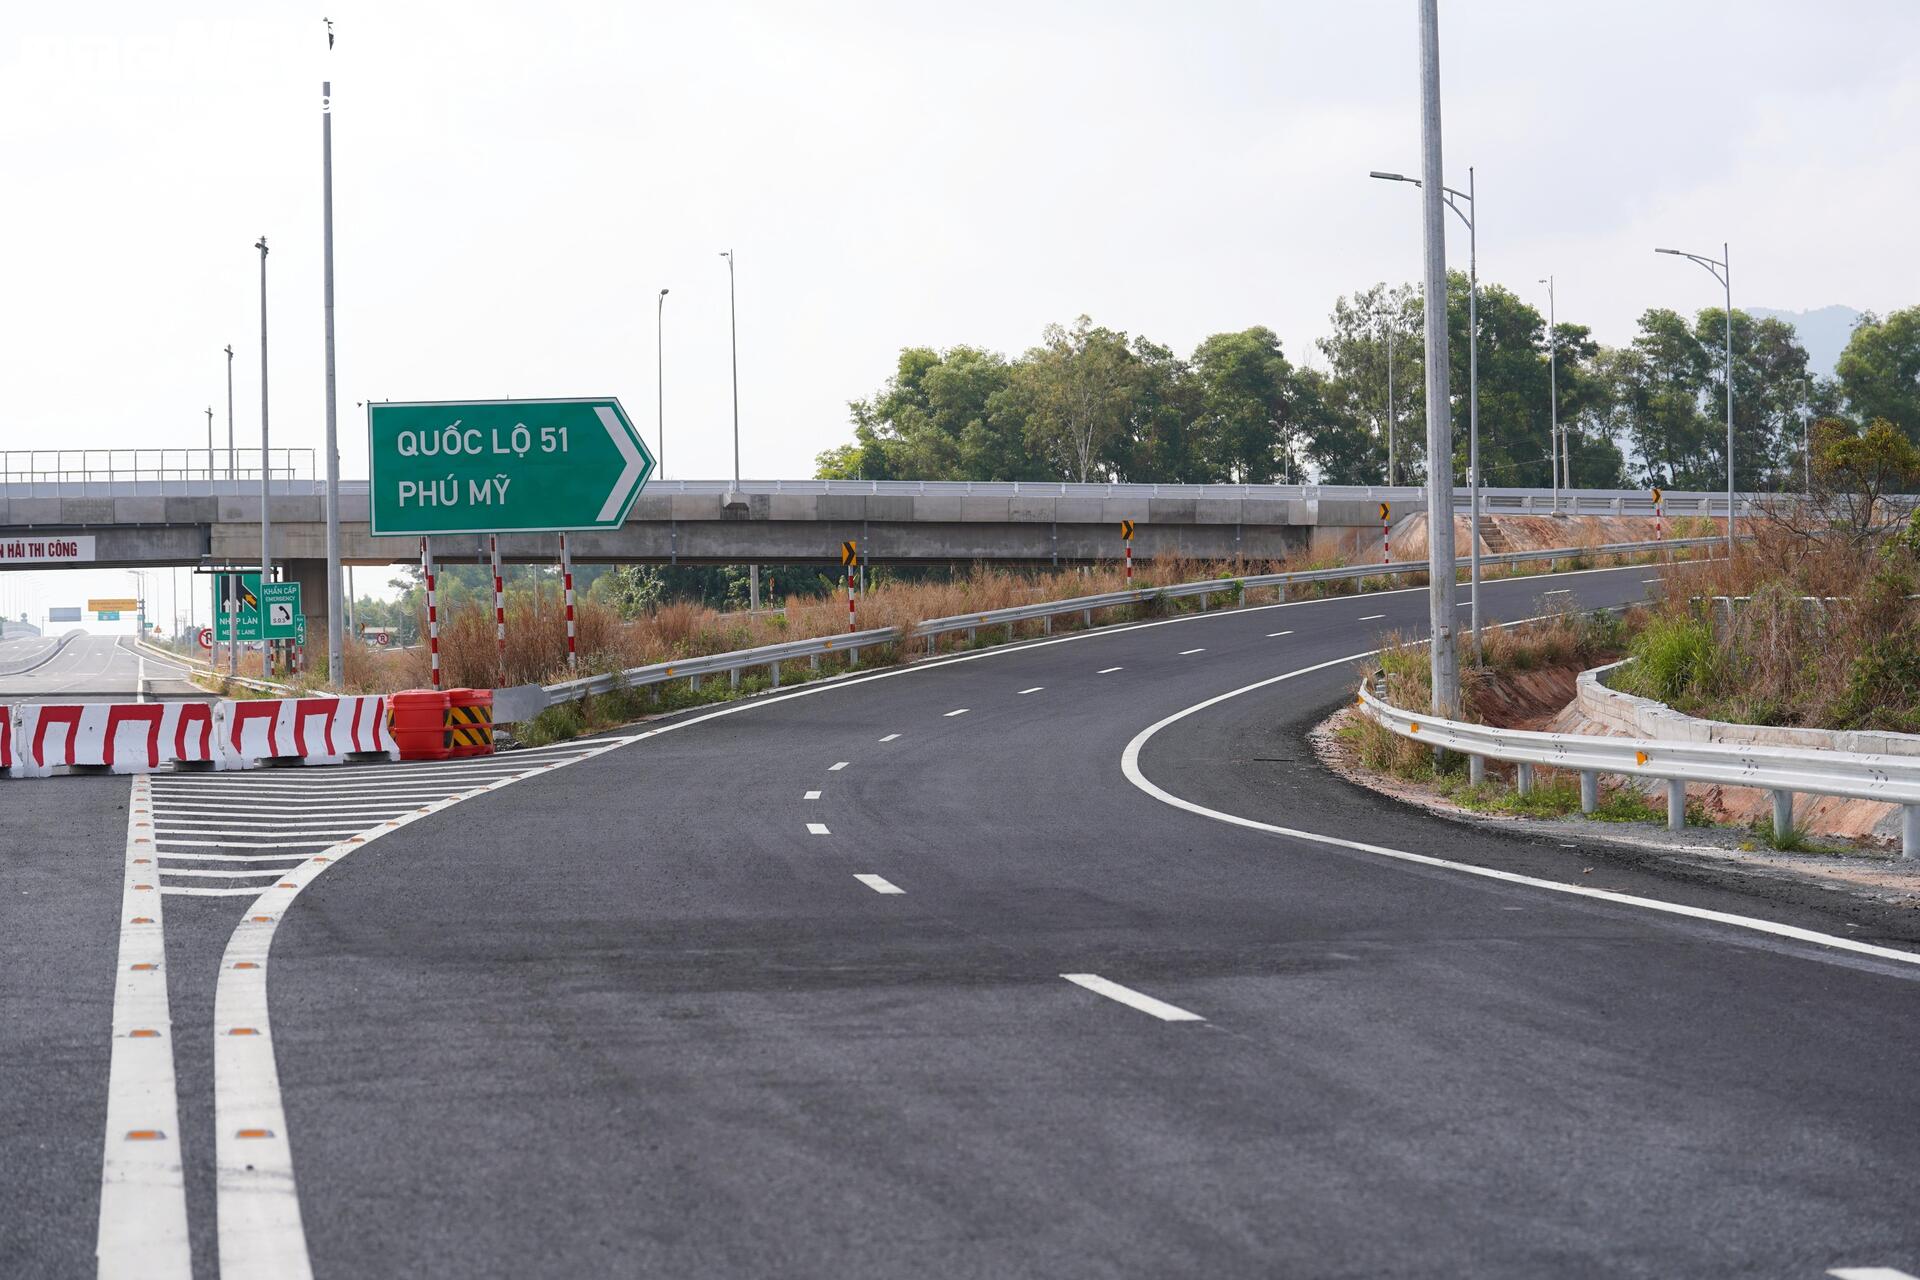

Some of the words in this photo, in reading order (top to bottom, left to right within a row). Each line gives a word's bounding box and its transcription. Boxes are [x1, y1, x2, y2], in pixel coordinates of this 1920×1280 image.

[397, 419, 483, 457] QUỐC
[491, 422, 531, 458] LỘ
[540, 426, 569, 453] 51
[398, 473, 459, 507] PHÚ
[469, 473, 511, 506] MỸ
[7, 539, 25, 558] HẢI
[28, 542, 45, 557] THI
[48, 538, 78, 557] CÔNG
[219, 617, 241, 625] NHP
[242, 615, 258, 625] LÀN
